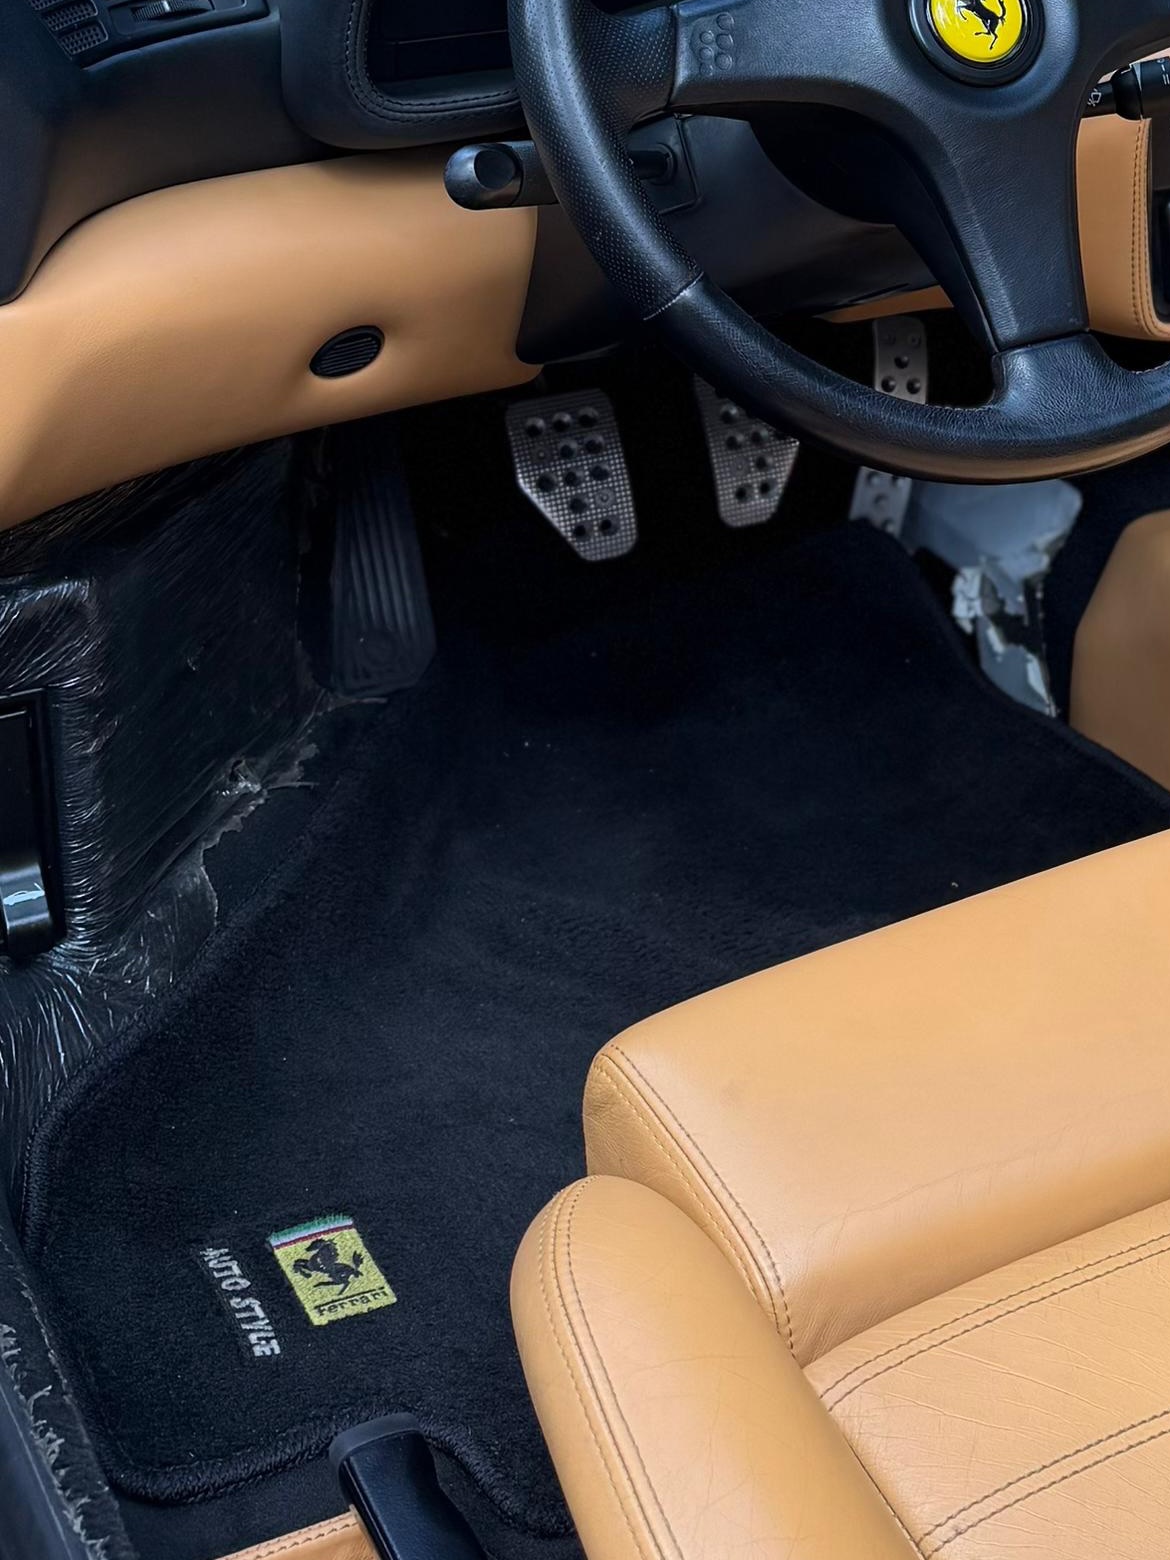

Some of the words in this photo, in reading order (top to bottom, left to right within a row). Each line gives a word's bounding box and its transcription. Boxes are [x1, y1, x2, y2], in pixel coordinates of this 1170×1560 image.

[200, 1247, 251, 1291] AUTO
[229, 1296, 281, 1357] STYLE
[313, 1286, 389, 1317] Ferrari
